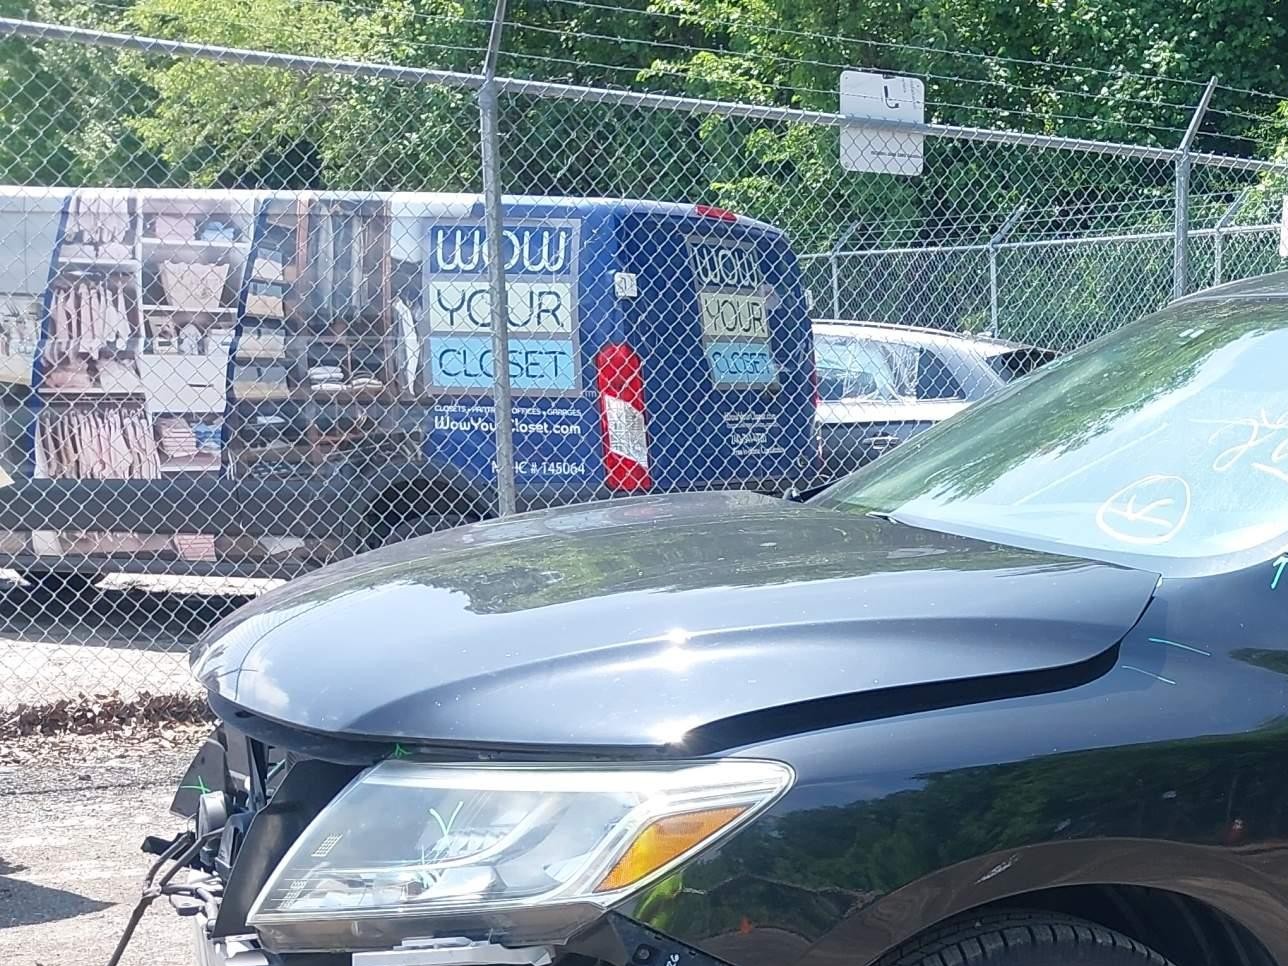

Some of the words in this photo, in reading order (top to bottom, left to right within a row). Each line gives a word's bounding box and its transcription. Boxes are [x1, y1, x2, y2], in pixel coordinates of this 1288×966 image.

[436, 229, 566, 272] WOW
[693, 247, 758, 288] WOW
[437, 288, 565, 328] YOUR
[705, 299, 765, 333] YOUR
[712, 351, 770, 374] CLOSET
[541, 462, 585, 475] 145064
